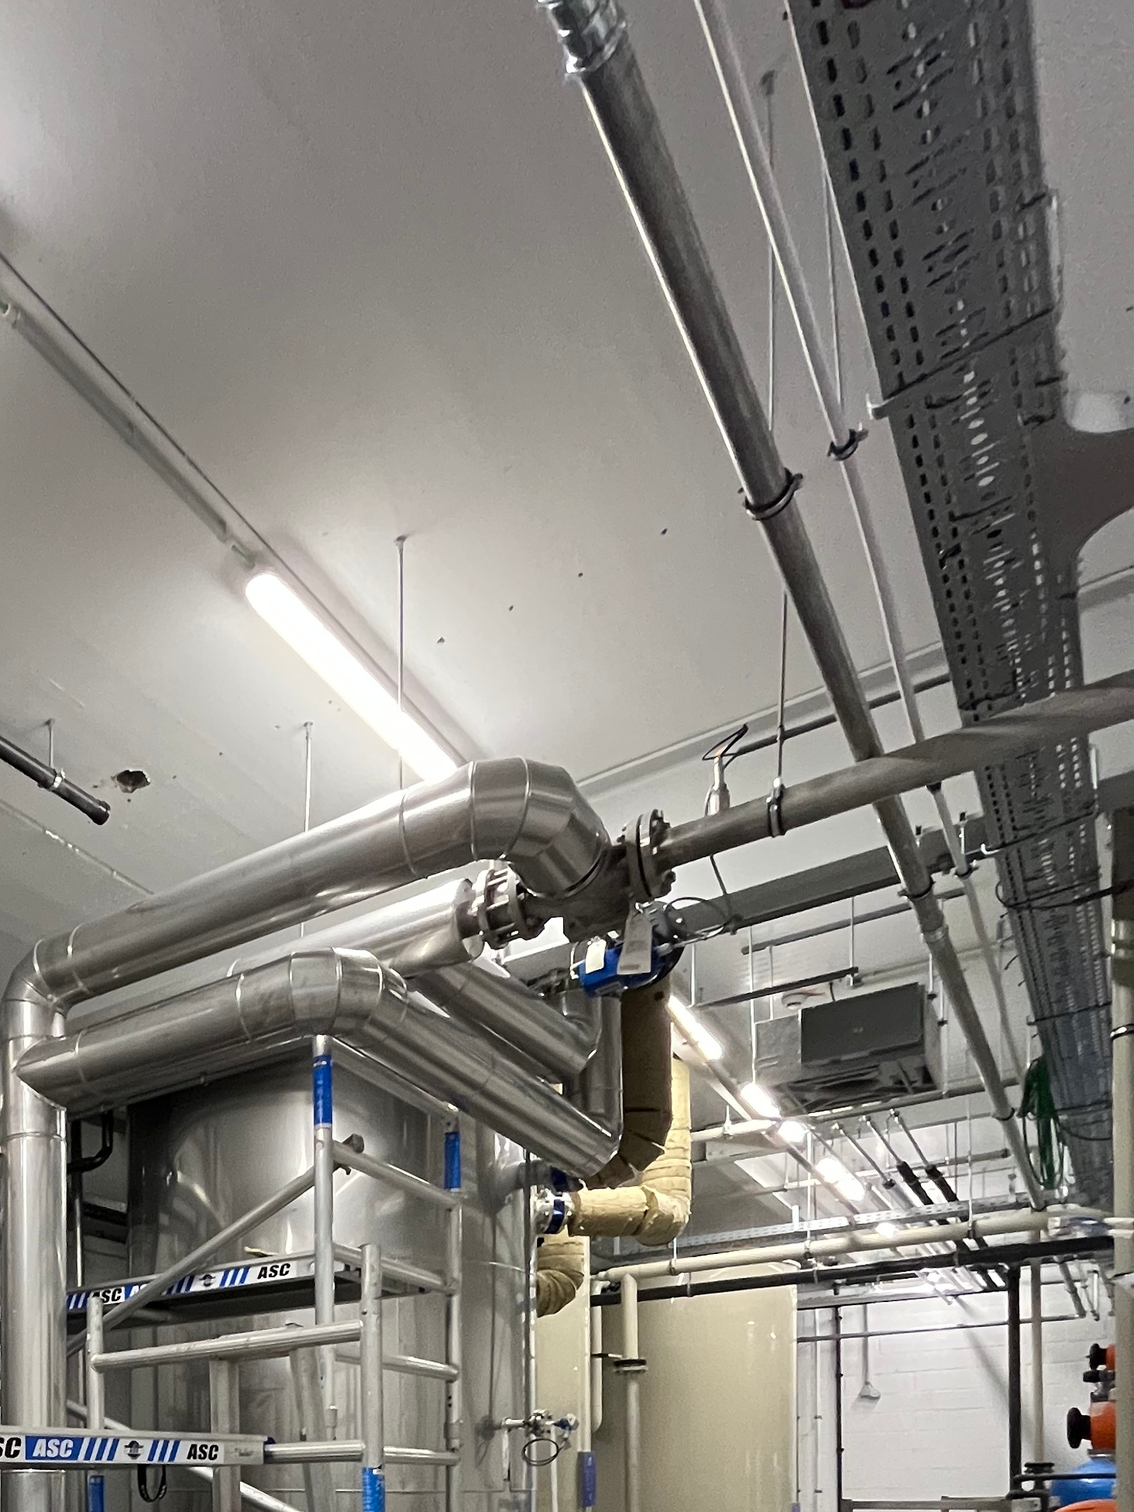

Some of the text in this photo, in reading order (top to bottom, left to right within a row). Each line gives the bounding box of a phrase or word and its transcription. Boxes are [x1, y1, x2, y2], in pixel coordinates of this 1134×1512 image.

[257, 1263, 291, 1280] ASC
[32, 1438, 73, 1458] ASC
[187, 1444, 219, 1461] ASC
